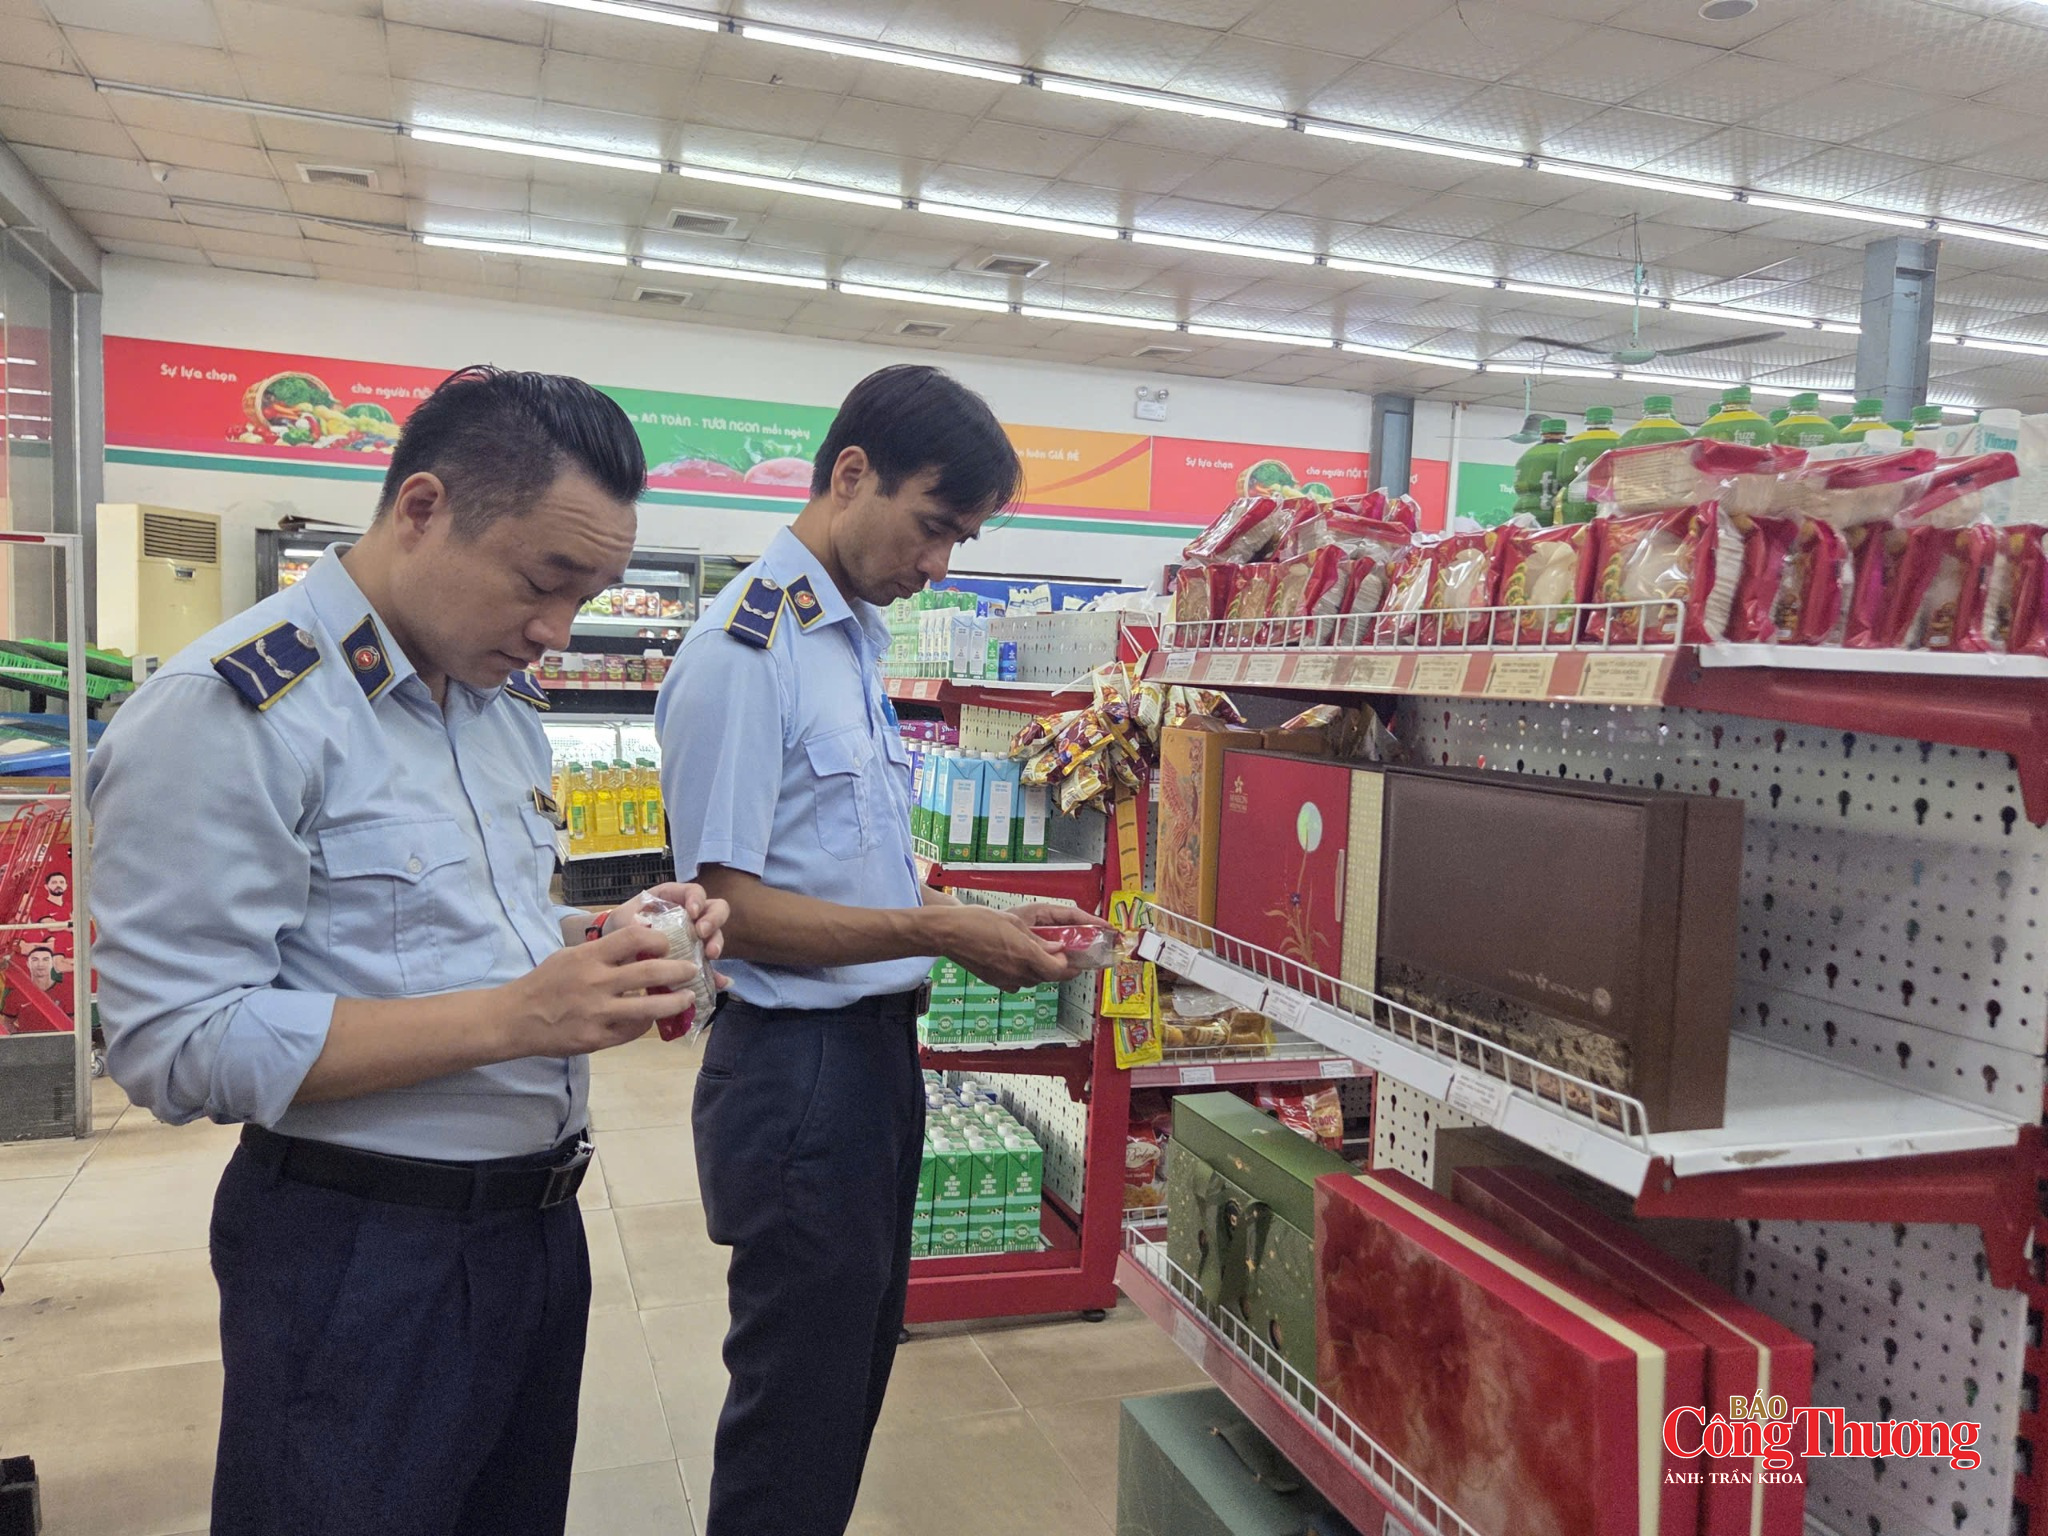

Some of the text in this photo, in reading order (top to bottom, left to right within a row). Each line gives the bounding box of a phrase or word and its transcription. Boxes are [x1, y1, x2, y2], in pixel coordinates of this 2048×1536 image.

[160, 363, 238, 383] Sự lựa chọn
[350, 382, 373, 395] cho
[641, 412, 658, 424] AN
[660, 412, 692, 427] TOÀN
[1185, 456, 1197, 468] Sự
